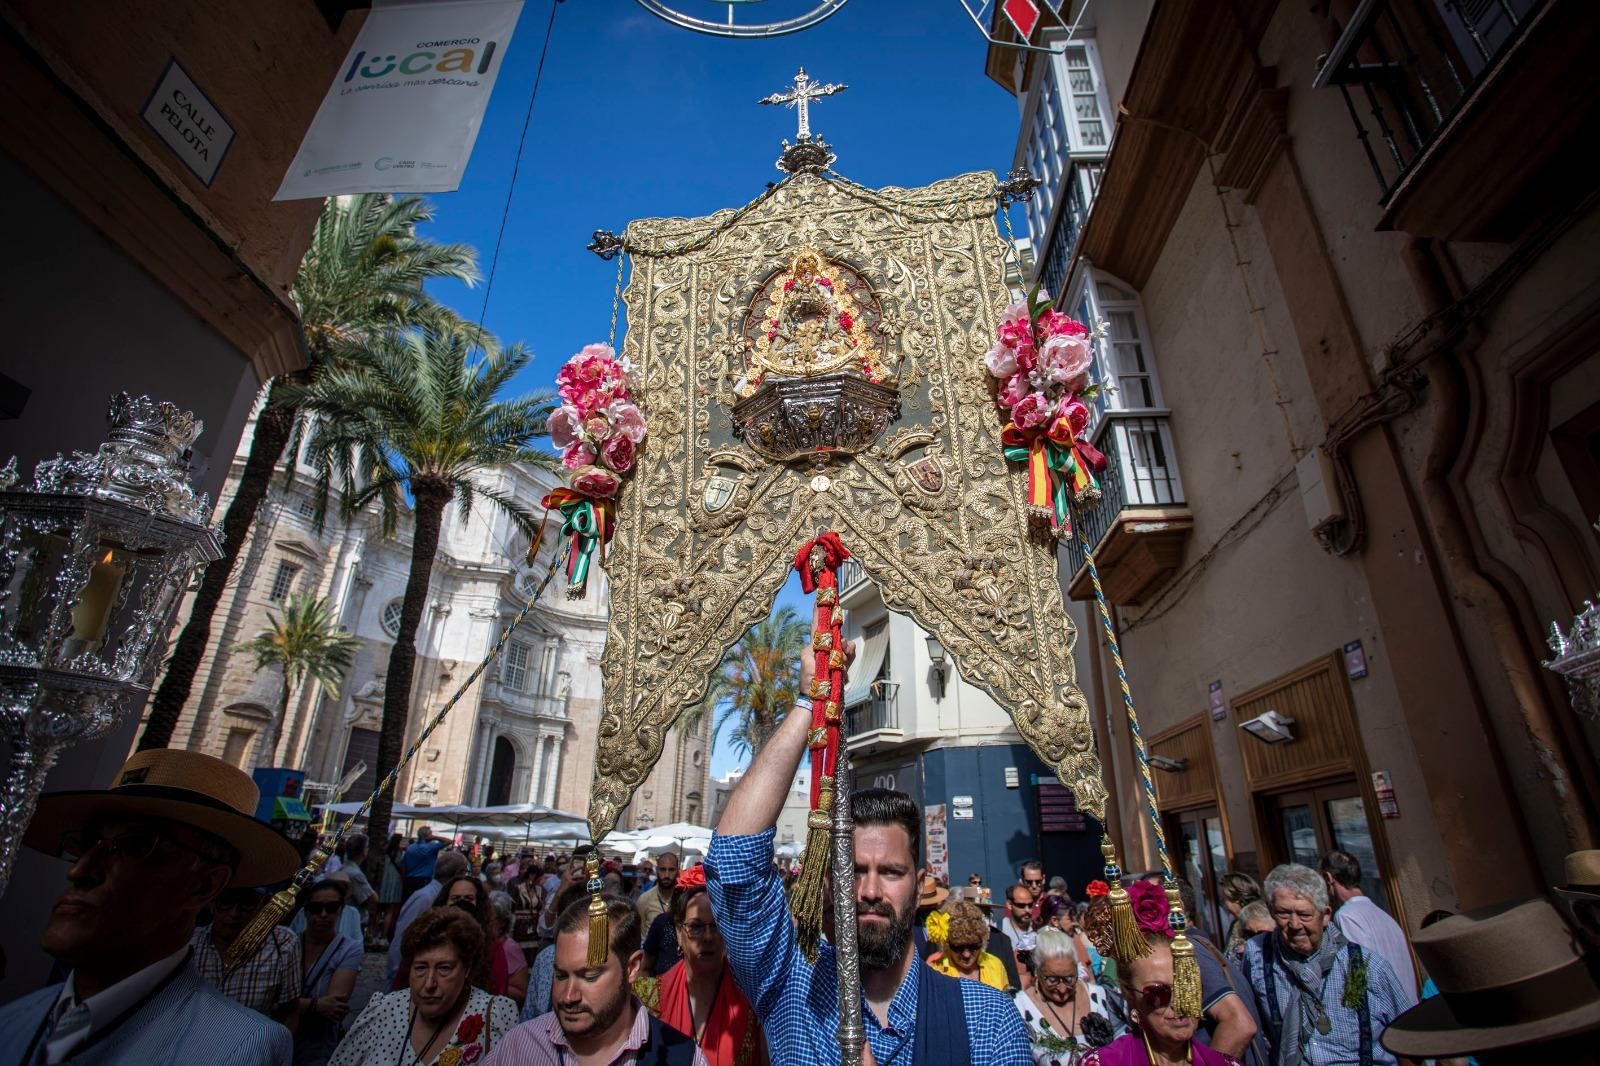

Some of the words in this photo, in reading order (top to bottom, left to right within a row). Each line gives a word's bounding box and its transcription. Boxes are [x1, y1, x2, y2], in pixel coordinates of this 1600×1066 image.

[416, 38, 481, 49] COMERCIO
[160, 102, 209, 162] PELOTA
[173, 89, 216, 142] CALLE
